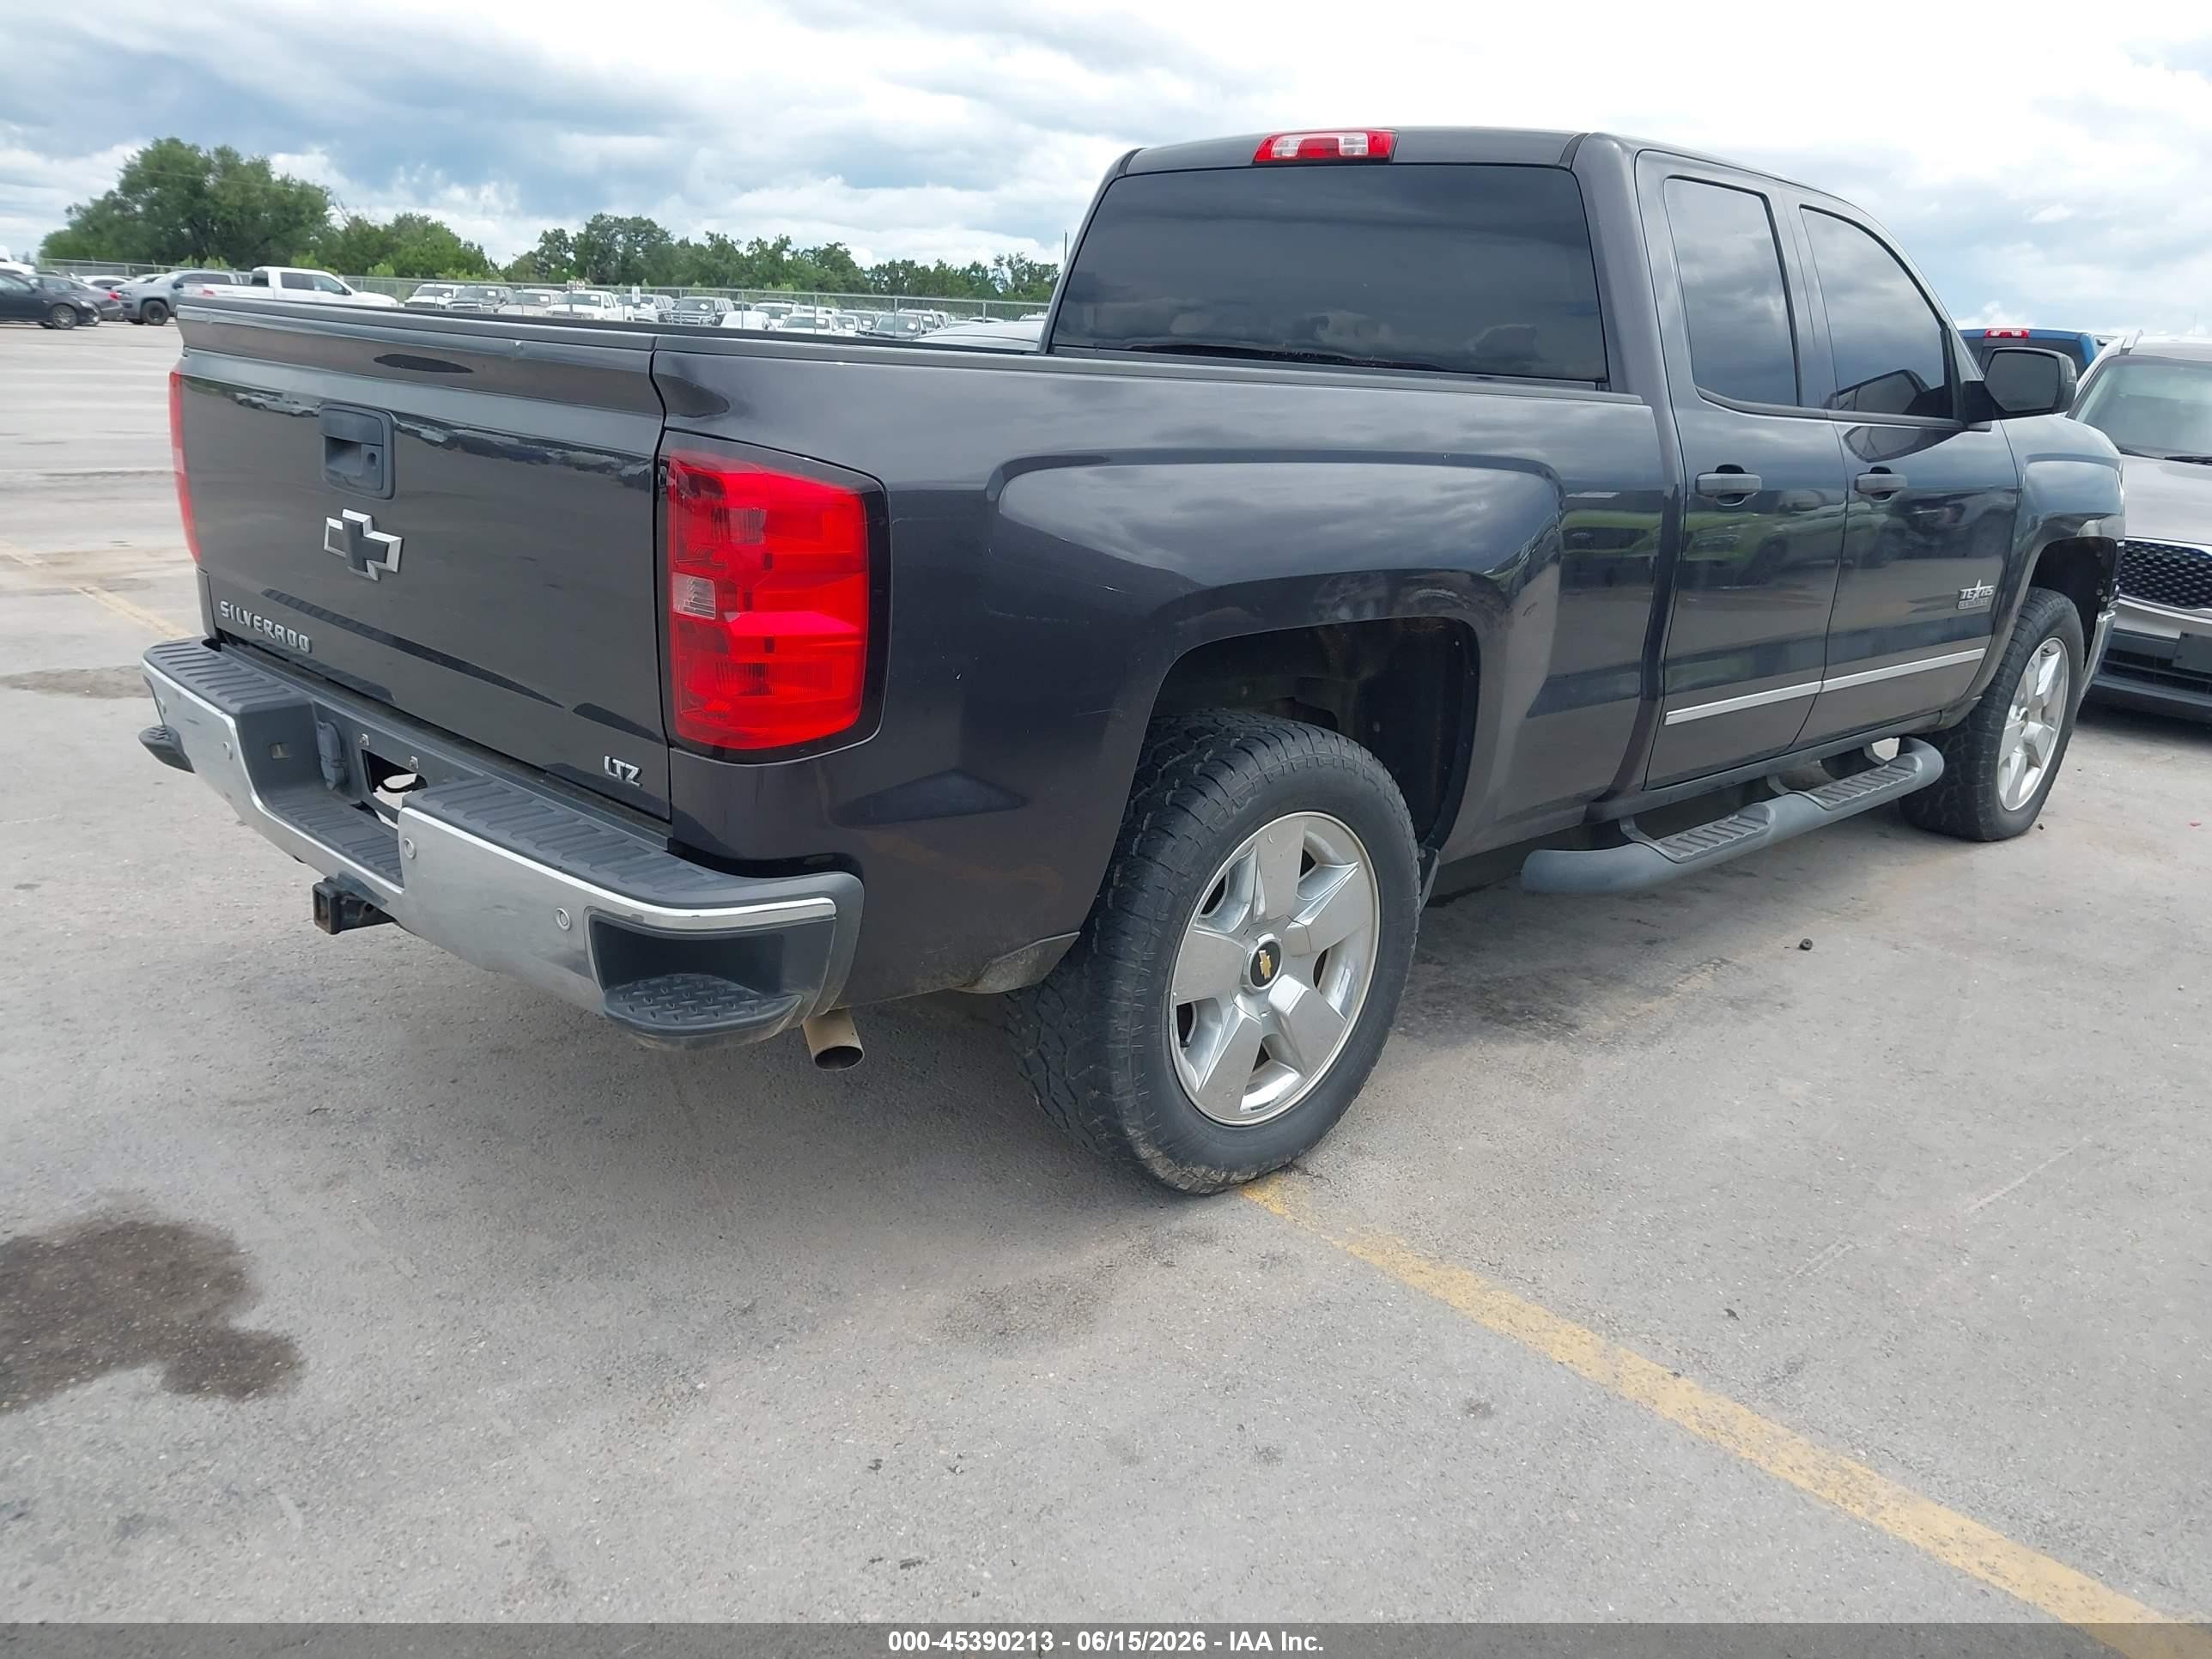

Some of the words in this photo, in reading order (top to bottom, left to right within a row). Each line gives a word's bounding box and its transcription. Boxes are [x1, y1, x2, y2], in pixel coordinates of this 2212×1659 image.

[1959, 579, 1995, 601] TEXAS
[220, 600, 312, 653] SILVERADO
[604, 755, 641, 787] LTZ
